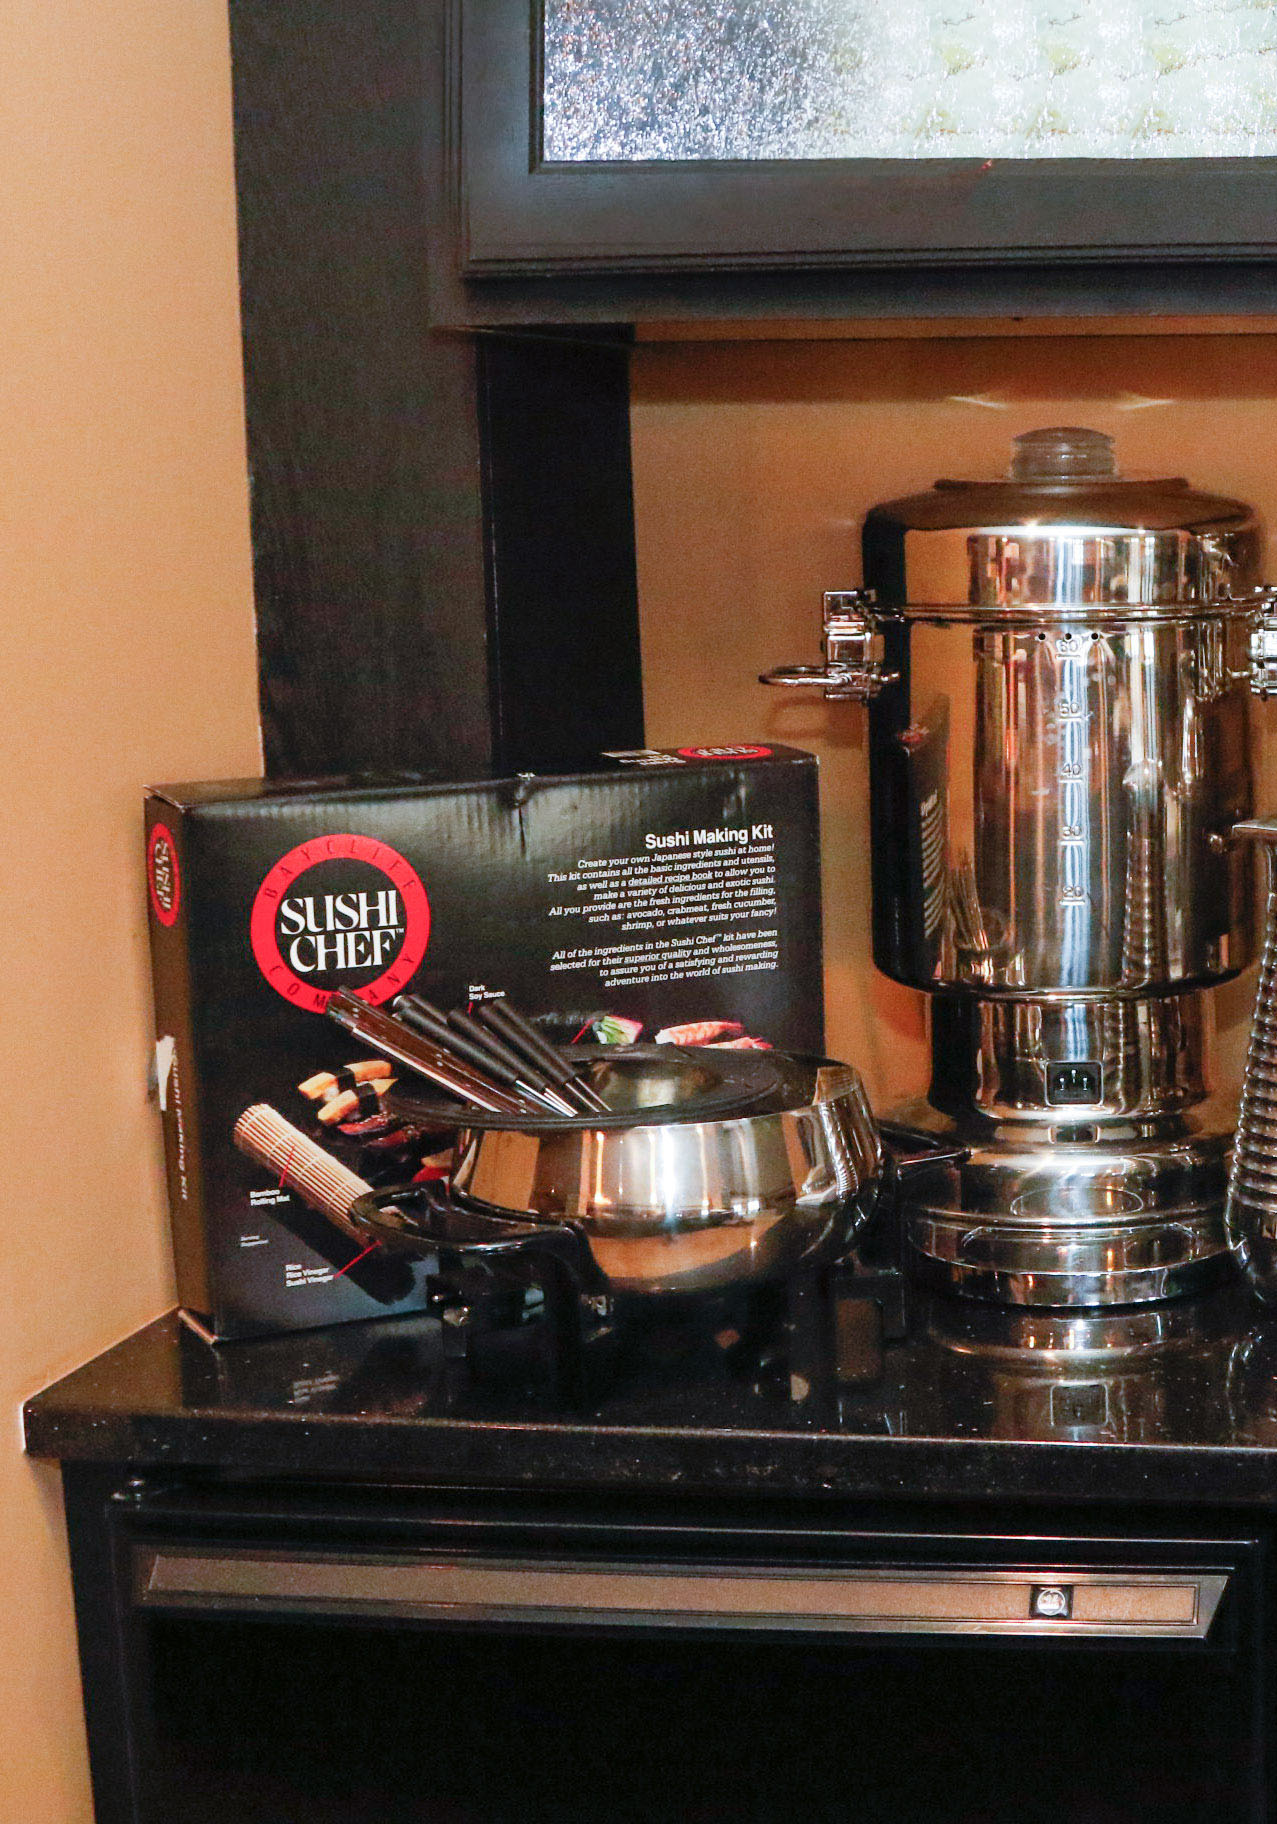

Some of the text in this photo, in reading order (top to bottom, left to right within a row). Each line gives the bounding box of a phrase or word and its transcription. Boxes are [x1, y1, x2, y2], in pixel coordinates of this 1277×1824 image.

[1057, 639, 1079, 653] 60
[1058, 701, 1080, 715] 50
[1062, 763, 1081, 776] 40
[645, 824, 774, 850] Sushi Making Kit
[1062, 825, 1082, 837] 30
[547, 854, 775, 883] This kit contains all the basic ingredients and utensils,
[577, 843, 775, 869] Create your own Japanese style sushi at home!
[576, 865, 776, 891] as well as a detailed recipe book to allow you to
[593, 891, 618, 901] make
[619, 890, 626, 898] a
[627, 887, 658, 897] variety
[658, 885, 669, 894] of
[668, 882, 707, 893] delicious
[707, 879, 724, 890] and
[725, 878, 751, 888] exotic
[548, 906, 563, 916] All
[563, 907, 581, 917] you
[581, 902, 617, 915] provide
[617, 901, 632, 909] are
[633, 899, 649, 908] the
[649, 896, 671, 907] fresh
[671, 892, 720, 905] ingredients
[720, 890, 733, 899] for
[734, 889, 749, 898] the
[1062, 885, 1084, 897] 20
[280, 889, 399, 935] SUSHI
[588, 897, 777, 923] such as: avocado, crabmeat, fresh cucumber,
[621, 906, 777, 931] shrimp, or whatever suits your fancy!
[549, 940, 778, 972] selected for their superior quality and wholesomeness,
[552, 950, 566, 960] All
[567, 949, 577, 958] of
[578, 948, 593, 957] the
[593, 944, 644, 957] ingredients
[645, 941, 654, 950] in
[655, 940, 670, 949] the
[670, 937, 695, 947] Sushi
[722, 932, 735, 942] kit
[736, 931, 757, 941] have
[757, 929, 778, 938] been
[599, 968, 609, 977] to
[610, 966, 639, 976] assure
[639, 963, 656, 974] you
[657, 961, 667, 970] of
[674, 956, 716, 969] satisfying
[717, 954, 734, 964] and
[735, 950, 779, 962] rewarding
[604, 960, 779, 987] adventure into the world of sushi making.
[268, 956, 415, 1009] COMANY
[468, 984, 486, 992] Dark
[468, 991, 506, 1001] Soy Sauce
[249, 1189, 281, 1199] Bamboo
[250, 1194, 290, 1206] Rolling Mat
[285, 1263, 302, 1271] Rice
[286, 1271, 303, 1279] Rice
